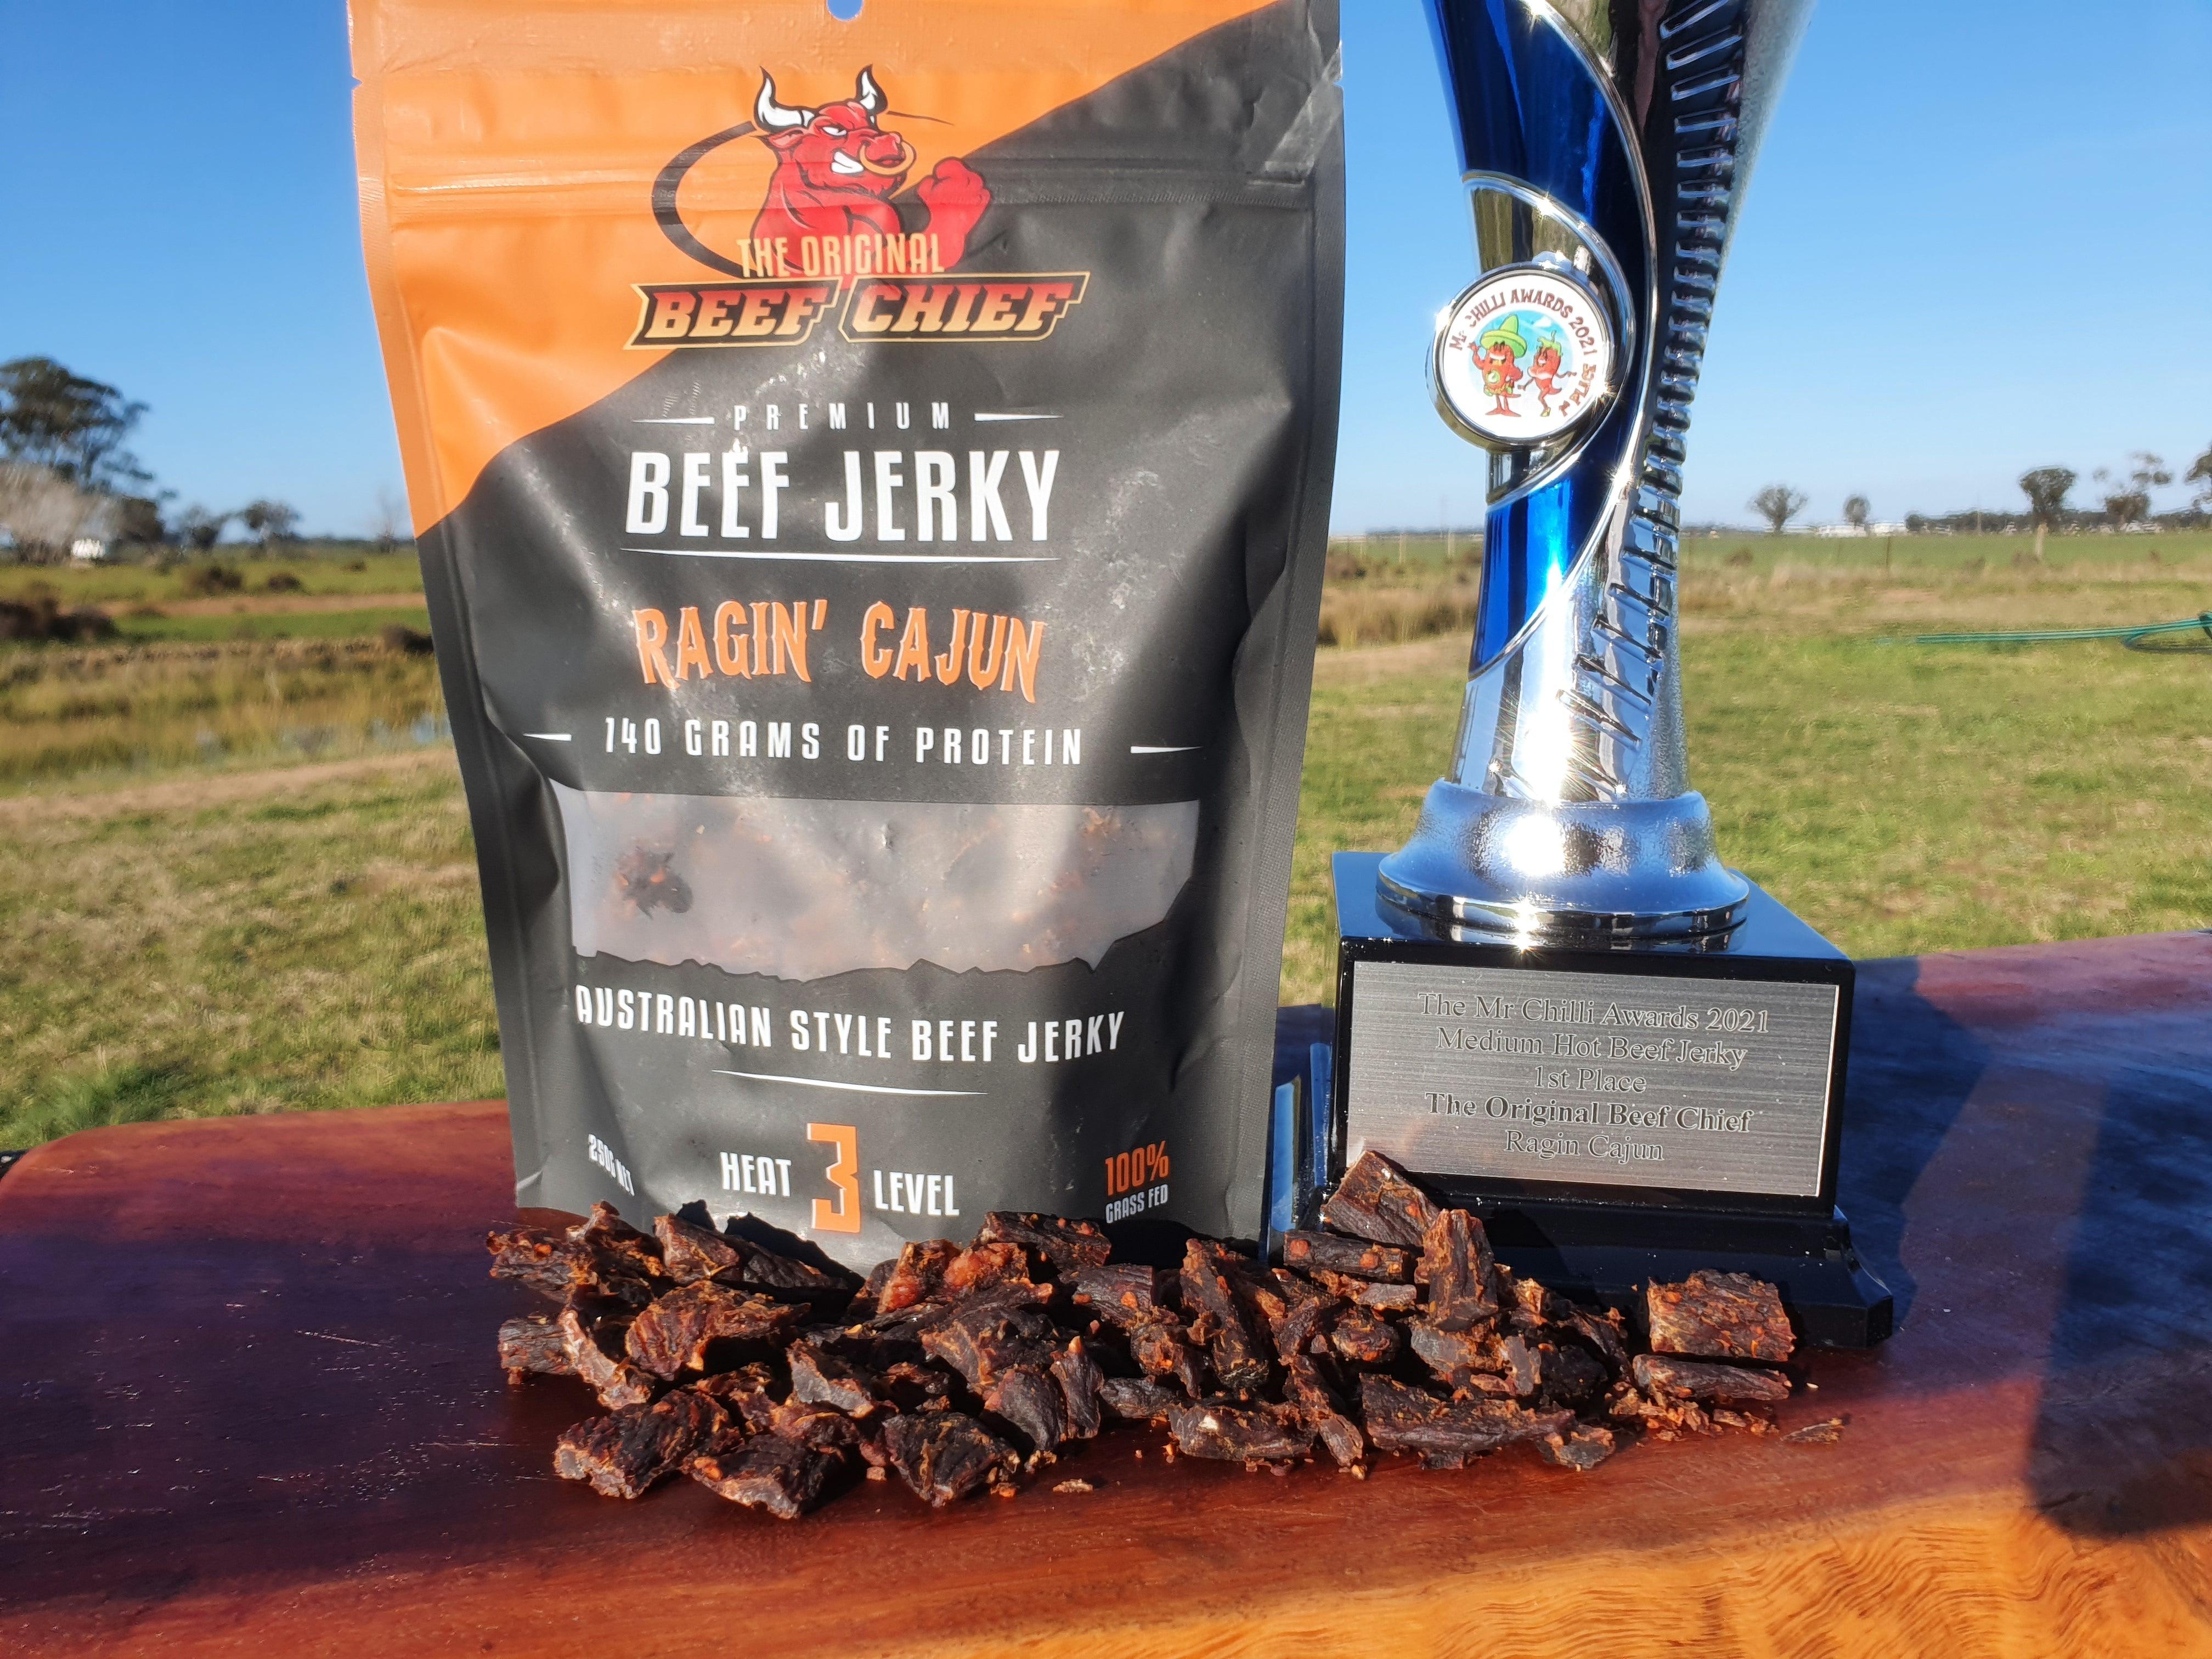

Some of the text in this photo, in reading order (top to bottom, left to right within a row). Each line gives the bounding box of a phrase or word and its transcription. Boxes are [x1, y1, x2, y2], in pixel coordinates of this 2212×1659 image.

[737, 233, 945, 279] THE ORIGINAL
[645, 283, 1073, 338] BEEF CHIEF
[1510, 288, 1573, 318] AWARDS
[1568, 316, 1598, 356] 2021
[733, 402, 949, 430] PREMIUM
[625, 450, 1059, 541] BEEF JERKY
[631, 599, 1044, 703] RAGIN' CAJUN
[605, 718, 1081, 765] 140 GRAMS OF PROTEIN
[575, 984, 1125, 1063] AUSTRALIAN STYLE BEEF JERKY
[1418, 992, 1769, 1033] The Mr Chilli Awards 2021
[1436, 1026, 1748, 1071] Medium Hot Beef Jerky
[1535, 1065, 1646, 1093] 1st Place
[1424, 1092, 1755, 1133] The Original Beef Chief
[1105, 1141, 1169, 1196] 100%
[1504, 1130, 1665, 1165] Ragin Cajun
[720, 1122, 960, 1233] HEAT 3 LEVEL
[1105, 1184, 1168, 1223] GRASS FED
